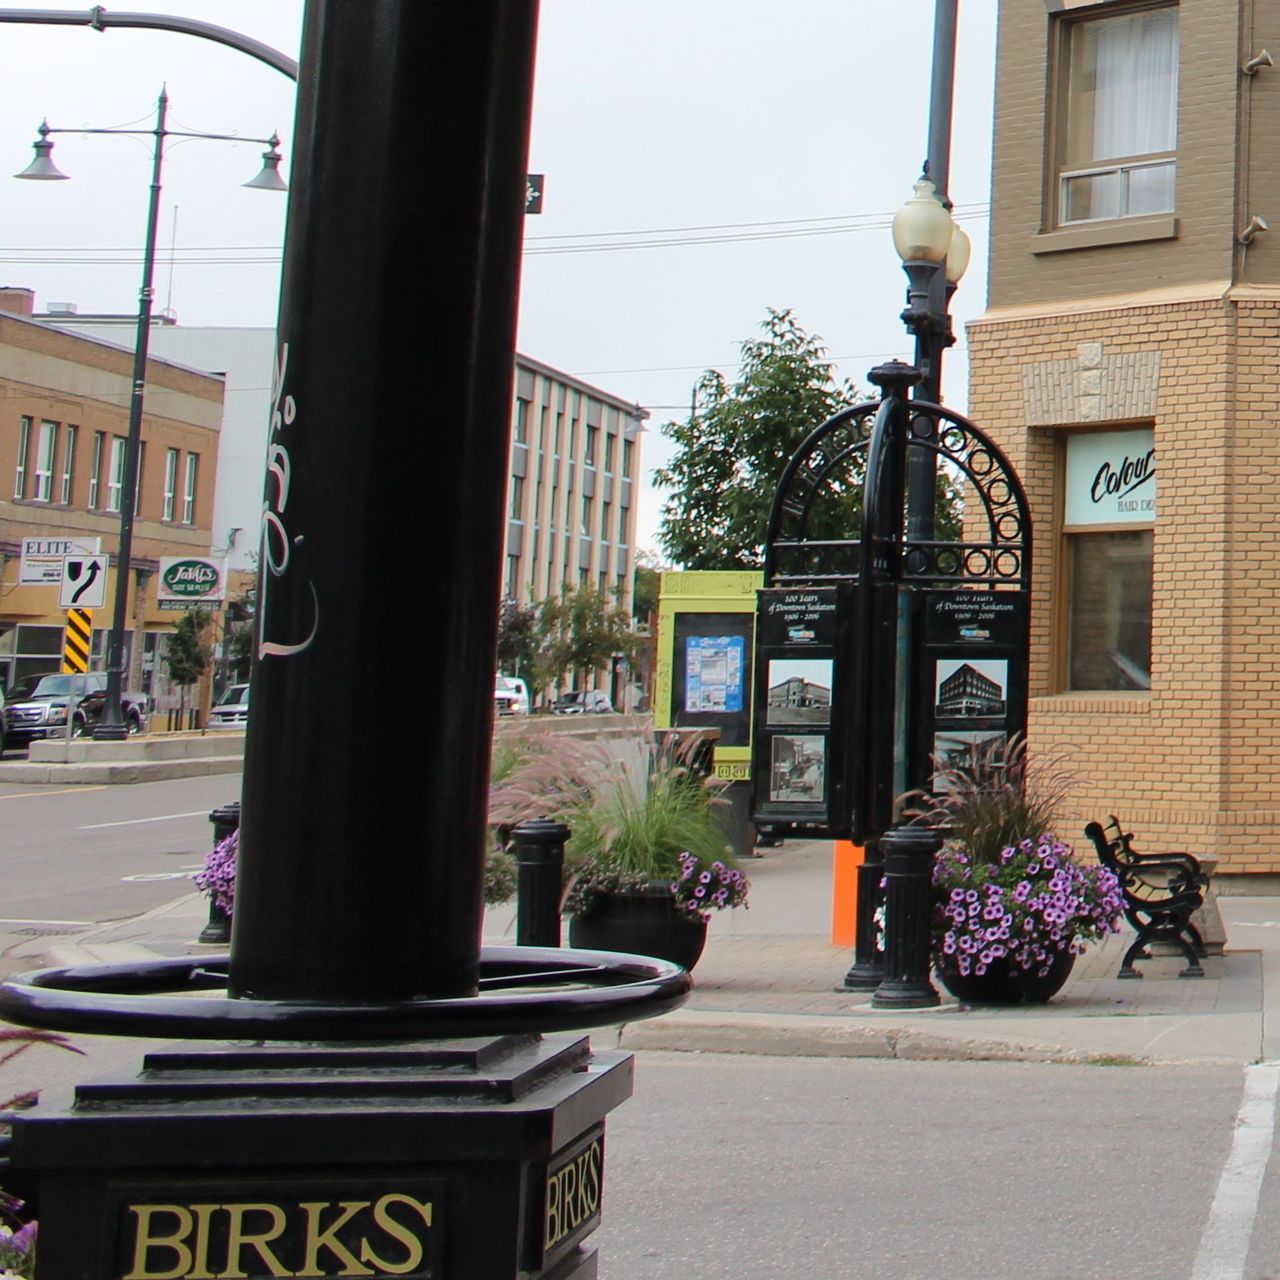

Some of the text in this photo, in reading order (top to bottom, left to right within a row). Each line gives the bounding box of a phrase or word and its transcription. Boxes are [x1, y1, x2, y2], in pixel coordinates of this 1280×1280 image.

[1091, 448, 1155, 503] Colour
[1117, 500, 1138, 512] HAIR
[26, 541, 73, 554] ELITE
[775, 603, 806, 612] Downtown
[807, 601, 836, 611] Saskatoon
[944, 602, 980, 611] Downtown
[981, 600, 1014, 610] Saskatoon
[545, 1140, 600, 1250] BIRKS
[122, 1193, 432, 1280] BIRKS
